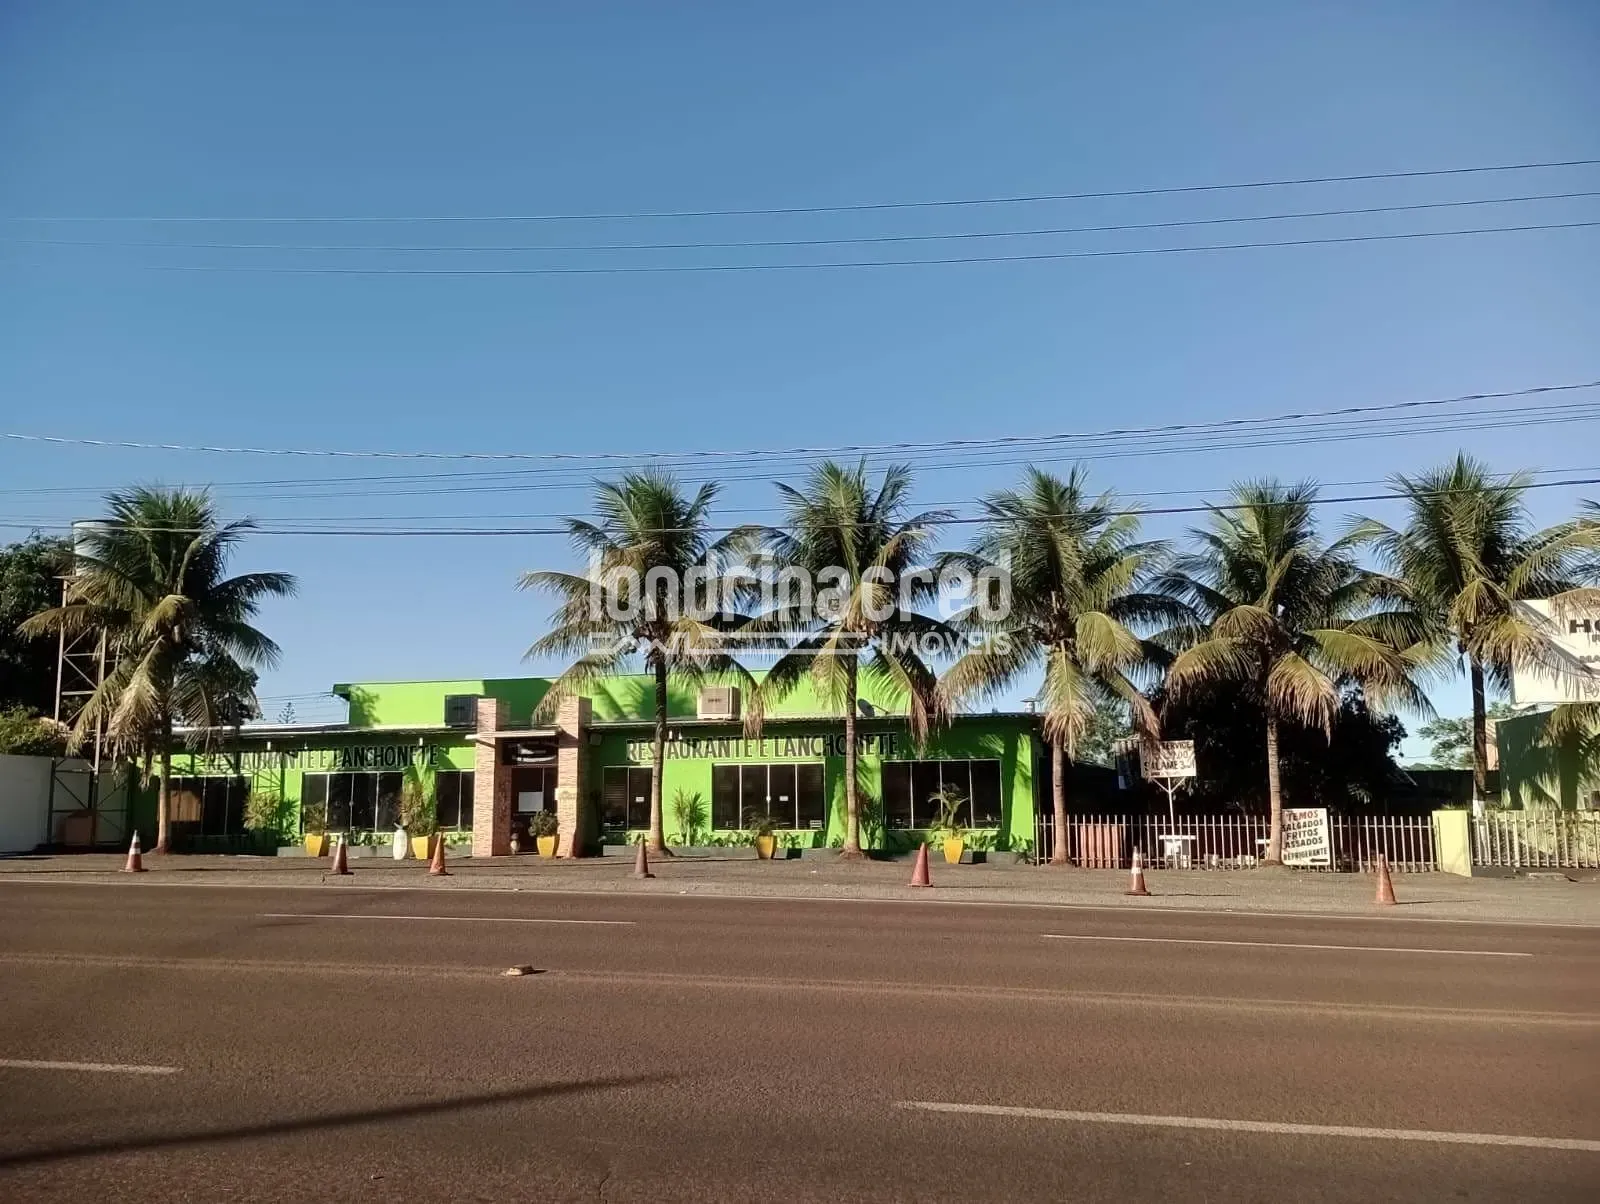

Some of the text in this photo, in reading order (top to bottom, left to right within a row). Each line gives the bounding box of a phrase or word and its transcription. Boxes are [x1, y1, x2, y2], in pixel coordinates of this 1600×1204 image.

[759, 735, 769, 757] E
[1286, 810, 1319, 821] TEMOS
[1286, 828, 1319, 840] FRITOS
[1285, 836, 1323, 849] ASSADOS
